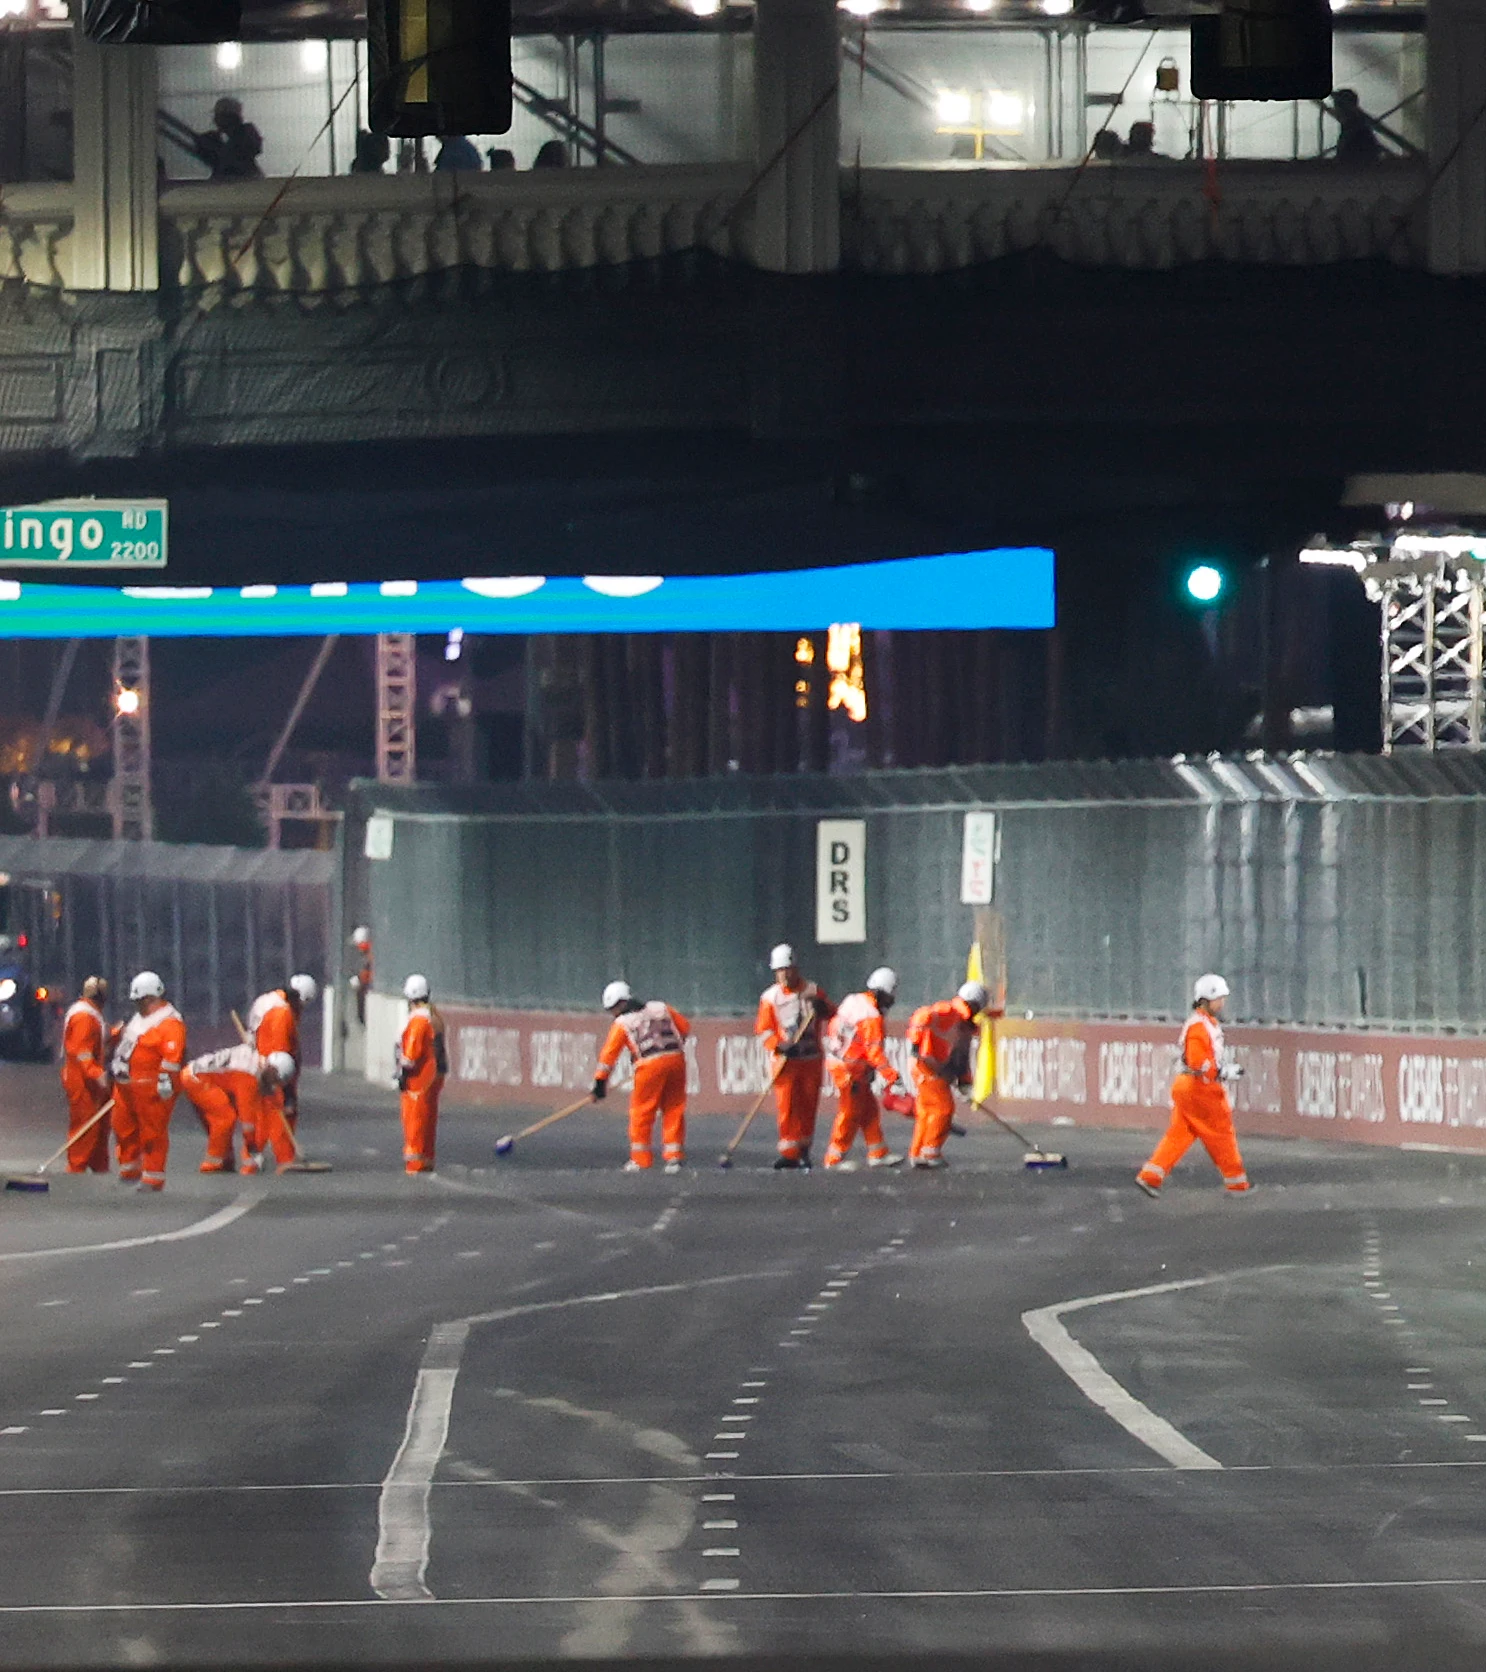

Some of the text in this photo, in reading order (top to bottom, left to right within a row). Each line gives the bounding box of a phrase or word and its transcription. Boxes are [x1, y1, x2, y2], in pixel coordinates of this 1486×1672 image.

[4, 509, 104, 560] ingo
[122, 509, 147, 530] RD
[111, 541, 159, 560] 2200
[831, 841, 849, 923] DRS
